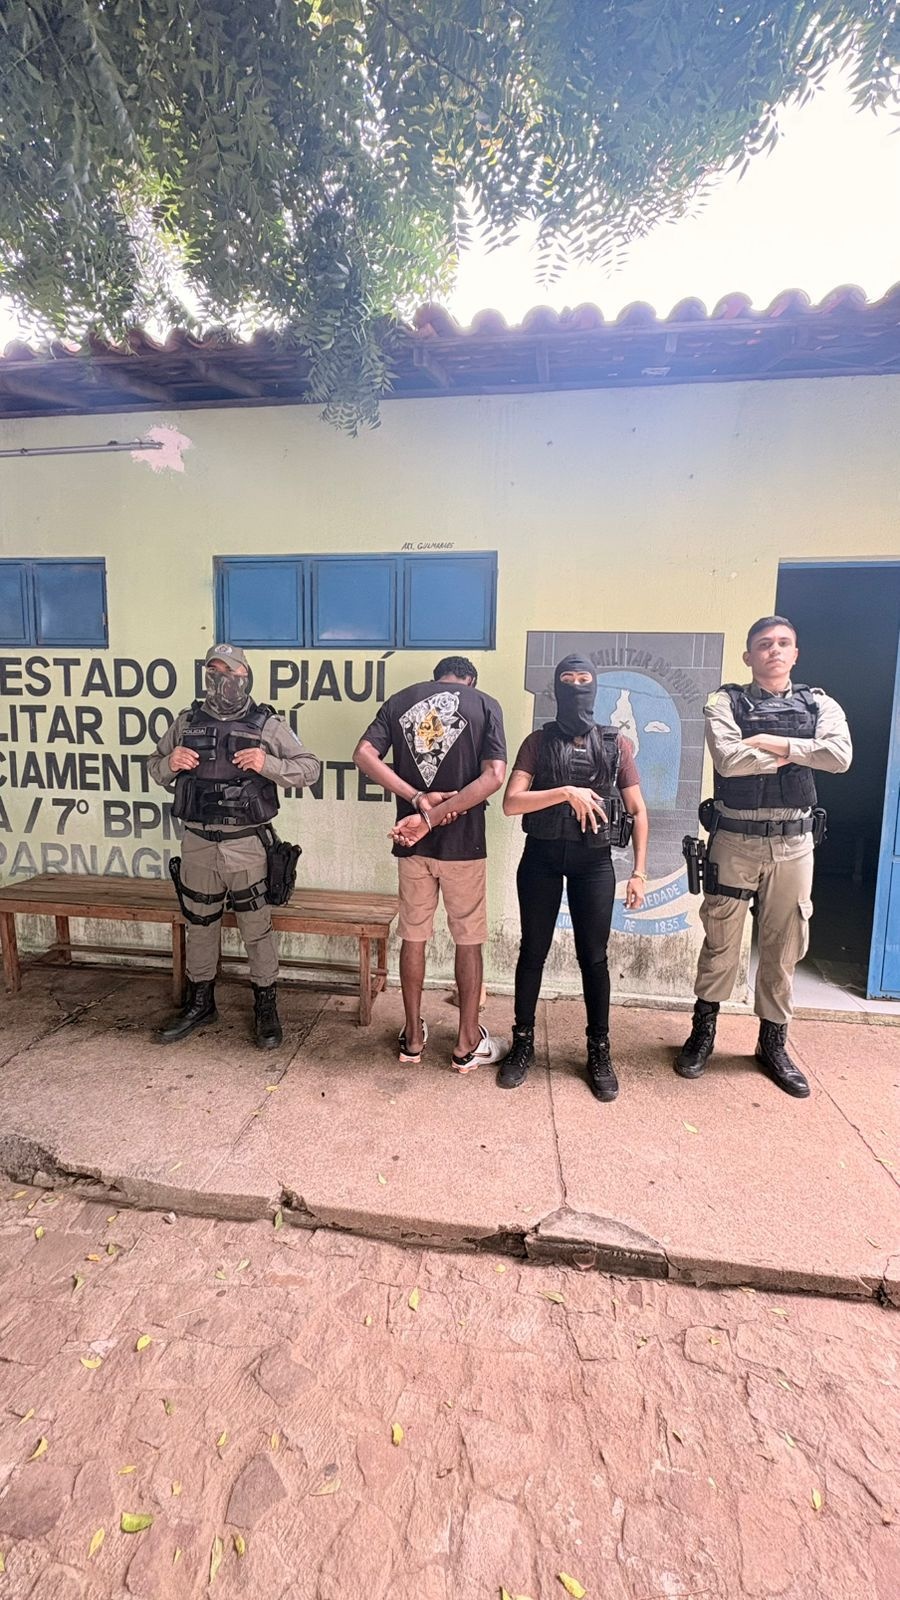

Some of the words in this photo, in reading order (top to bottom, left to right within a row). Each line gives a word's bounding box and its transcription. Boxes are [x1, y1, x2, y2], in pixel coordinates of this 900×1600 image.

[0, 655, 178, 699] ESTADO
[269, 651, 395, 702] PIAUÍ
[655, 918, 680, 933] 1835
